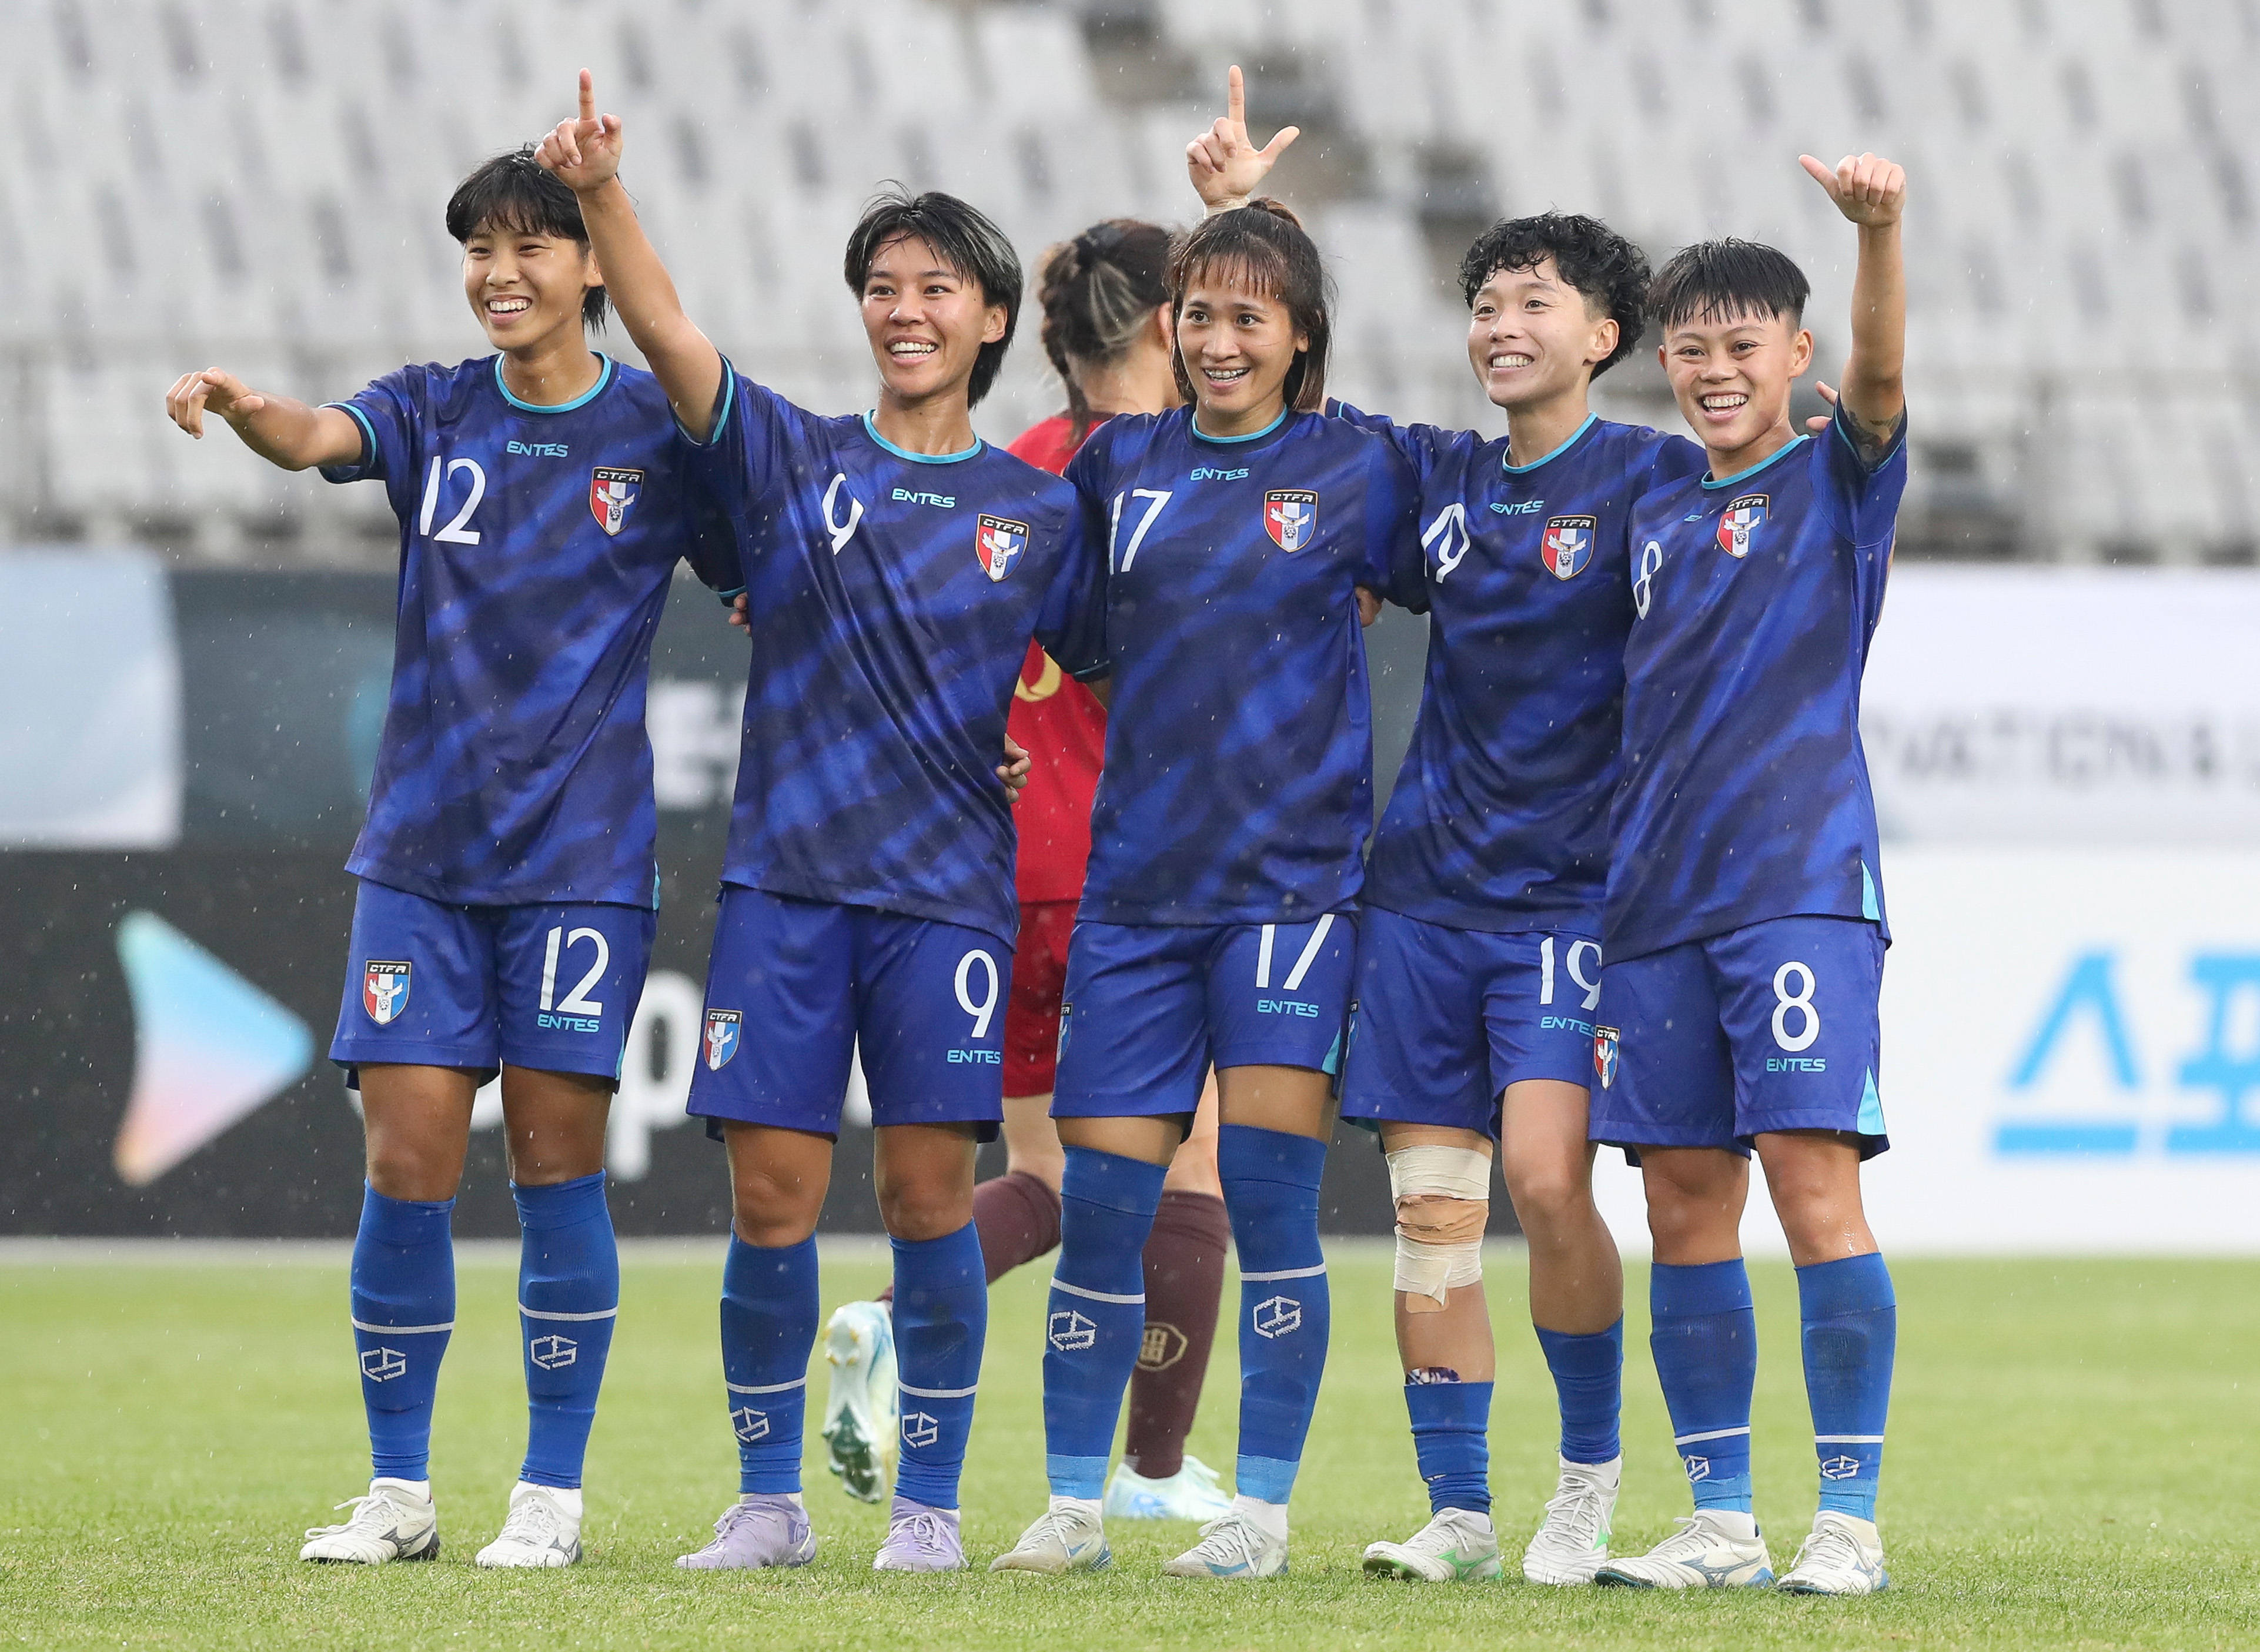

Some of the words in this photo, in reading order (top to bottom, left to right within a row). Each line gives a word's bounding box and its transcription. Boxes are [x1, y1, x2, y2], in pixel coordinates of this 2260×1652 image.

[506, 440, 569, 458] ENTES
[597, 471, 640, 483] CTFA
[1190, 467, 1249, 481] ENTES
[420, 455, 486, 545] 12
[891, 488, 955, 509] ENTES
[1271, 493, 1313, 503] CTFA
[1726, 498, 1764, 513] CTFA
[821, 473, 864, 556] 9
[1490, 500, 1544, 516] ENTES
[983, 519, 1025, 534] CTFA
[1109, 489, 1173, 576] 17
[1550, 519, 1591, 528] CTFA
[1633, 540, 1663, 620] 8
[369, 965, 407, 974] CTFA
[539, 926, 610, 1016] 12
[1540, 937, 1602, 1011] 19
[954, 949, 998, 1038] 9
[1257, 999, 1319, 1018] ENTES
[1771, 961, 1820, 1052] 8
[537, 1014, 600, 1033] ENTES
[710, 1013, 738, 1022] CTFA
[947, 1049, 1001, 1065] ENTES
[1766, 1058, 1826, 1072] ENTES
